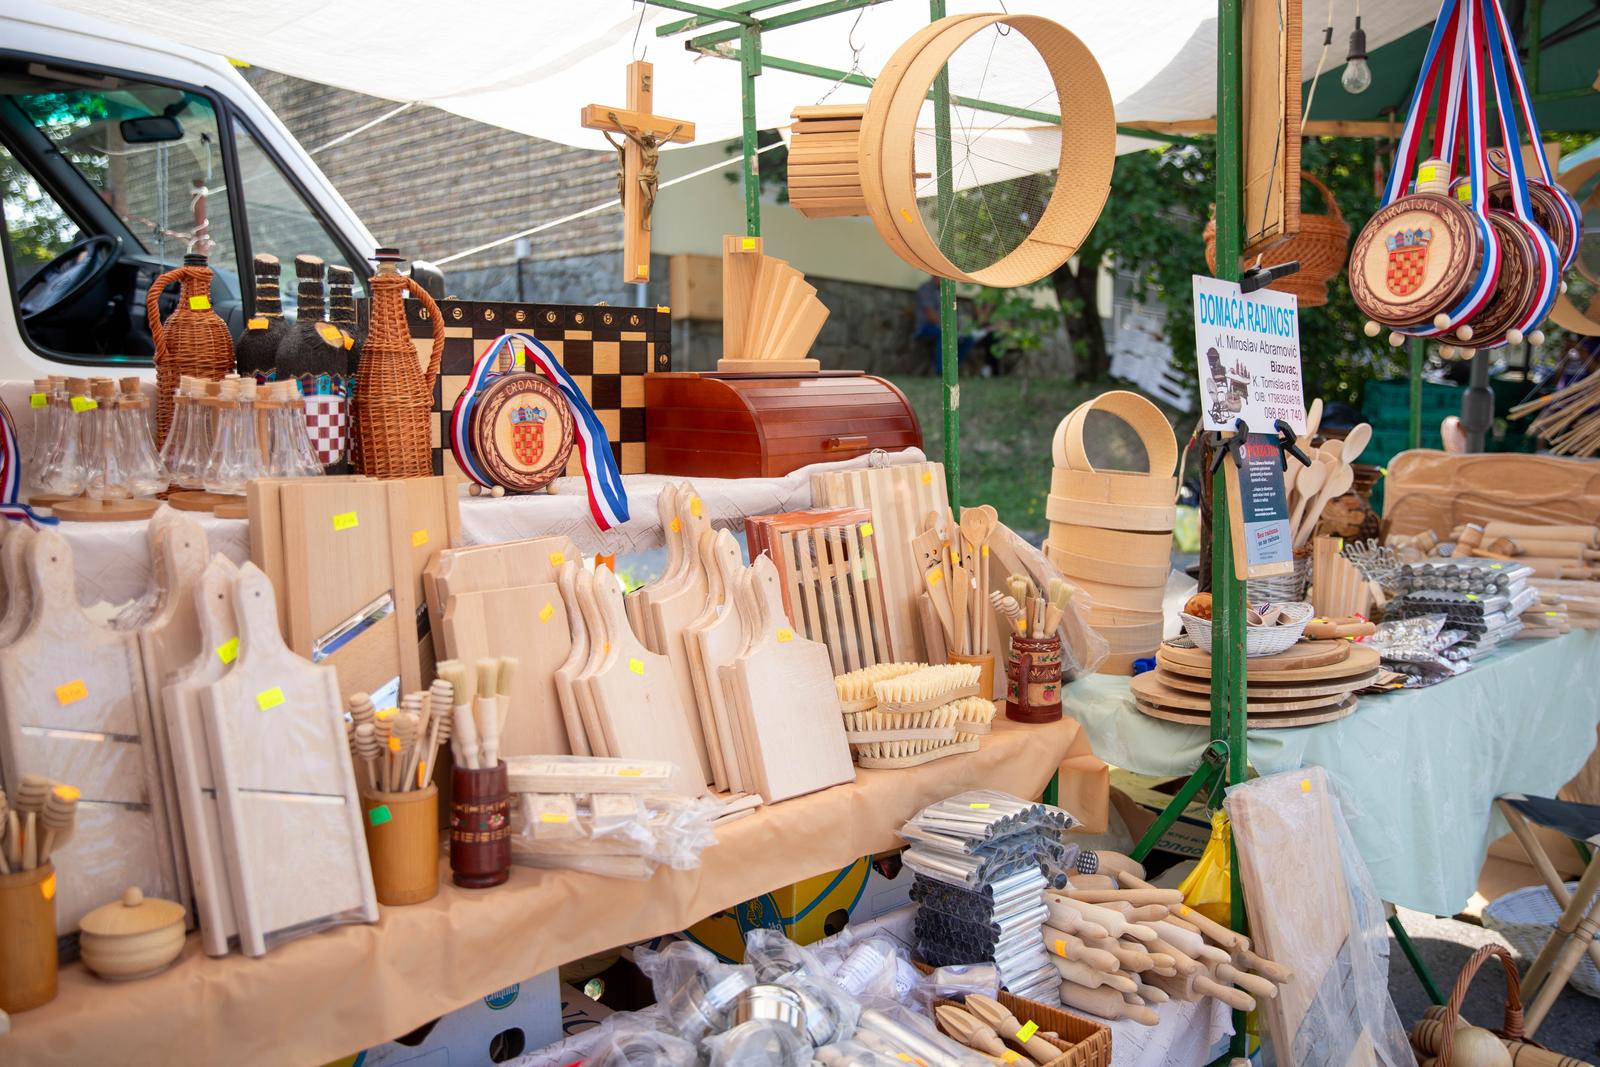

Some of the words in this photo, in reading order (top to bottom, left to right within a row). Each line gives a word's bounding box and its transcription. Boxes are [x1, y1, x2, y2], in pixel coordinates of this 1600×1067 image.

[1379, 200, 1438, 224] HRVATSKA
[1200, 290, 1245, 331] DOMAĆA
[1247, 301, 1294, 338] RADINOST
[1215, 334, 1224, 348] vl.
[1226, 335, 1258, 353] Miroslav
[1260, 340, 1297, 358] Abramović
[1270, 361, 1298, 376] Bizovac,
[505, 380, 551, 397] CROATIA
[1252, 376, 1260, 387] K.
[1261, 377, 1291, 391] Tomislava
[1292, 382, 1300, 392] 66
[1264, 406, 1276, 419] 098
[1277, 407, 1289, 420] 691
[1290, 409, 1302, 421] 740
